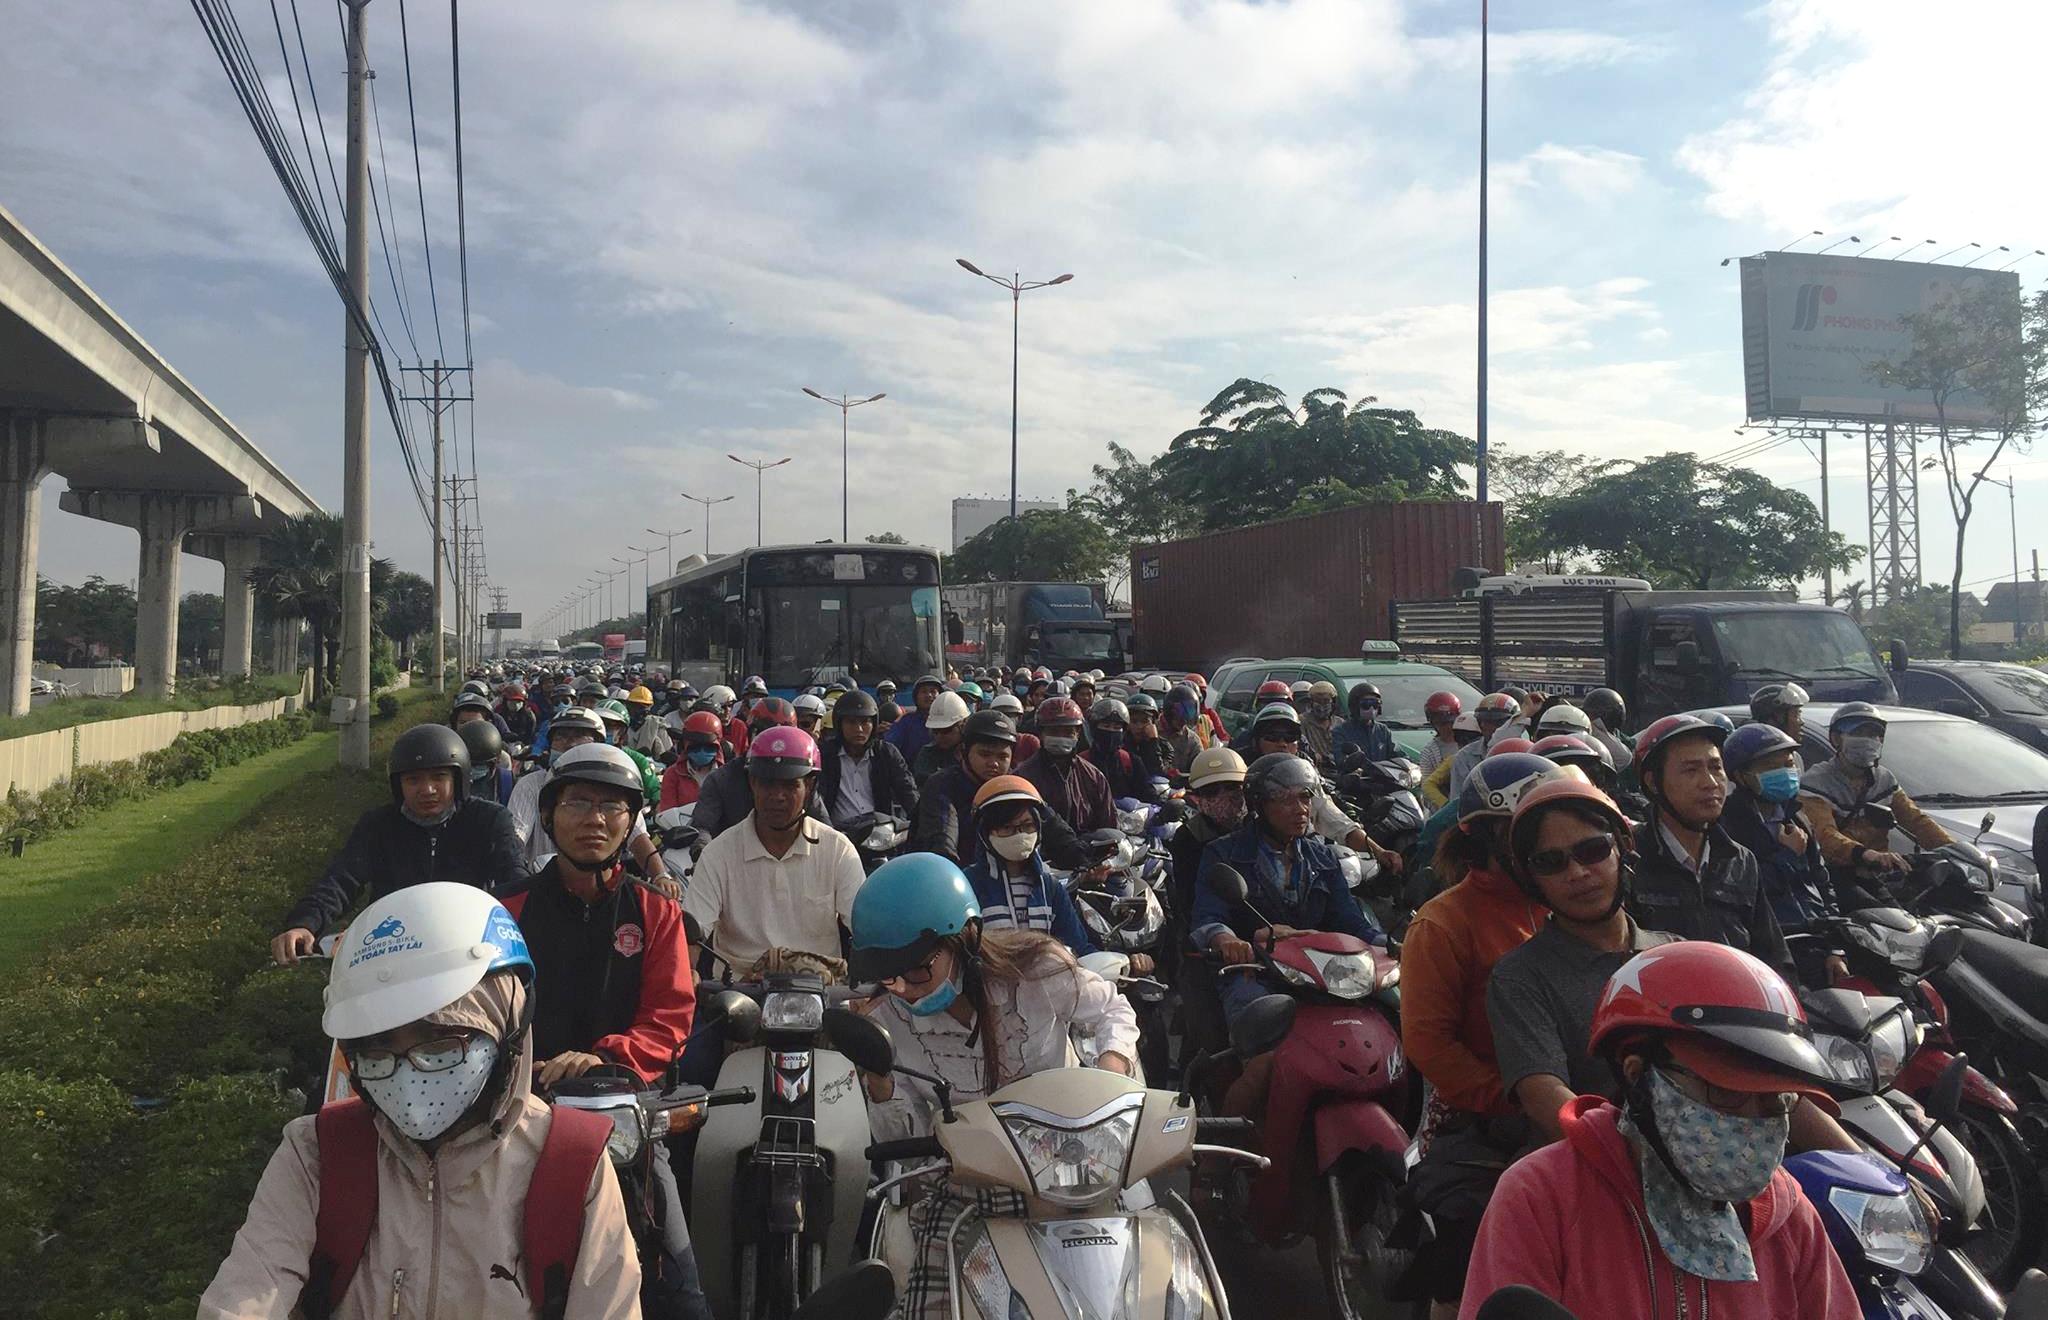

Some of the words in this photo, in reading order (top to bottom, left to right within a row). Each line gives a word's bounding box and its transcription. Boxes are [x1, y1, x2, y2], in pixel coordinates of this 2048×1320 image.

[1523, 683, 1575, 696] HYUNDAI
[388, 944, 404, 953] TAY
[1062, 1236, 1118, 1248] HONDA
